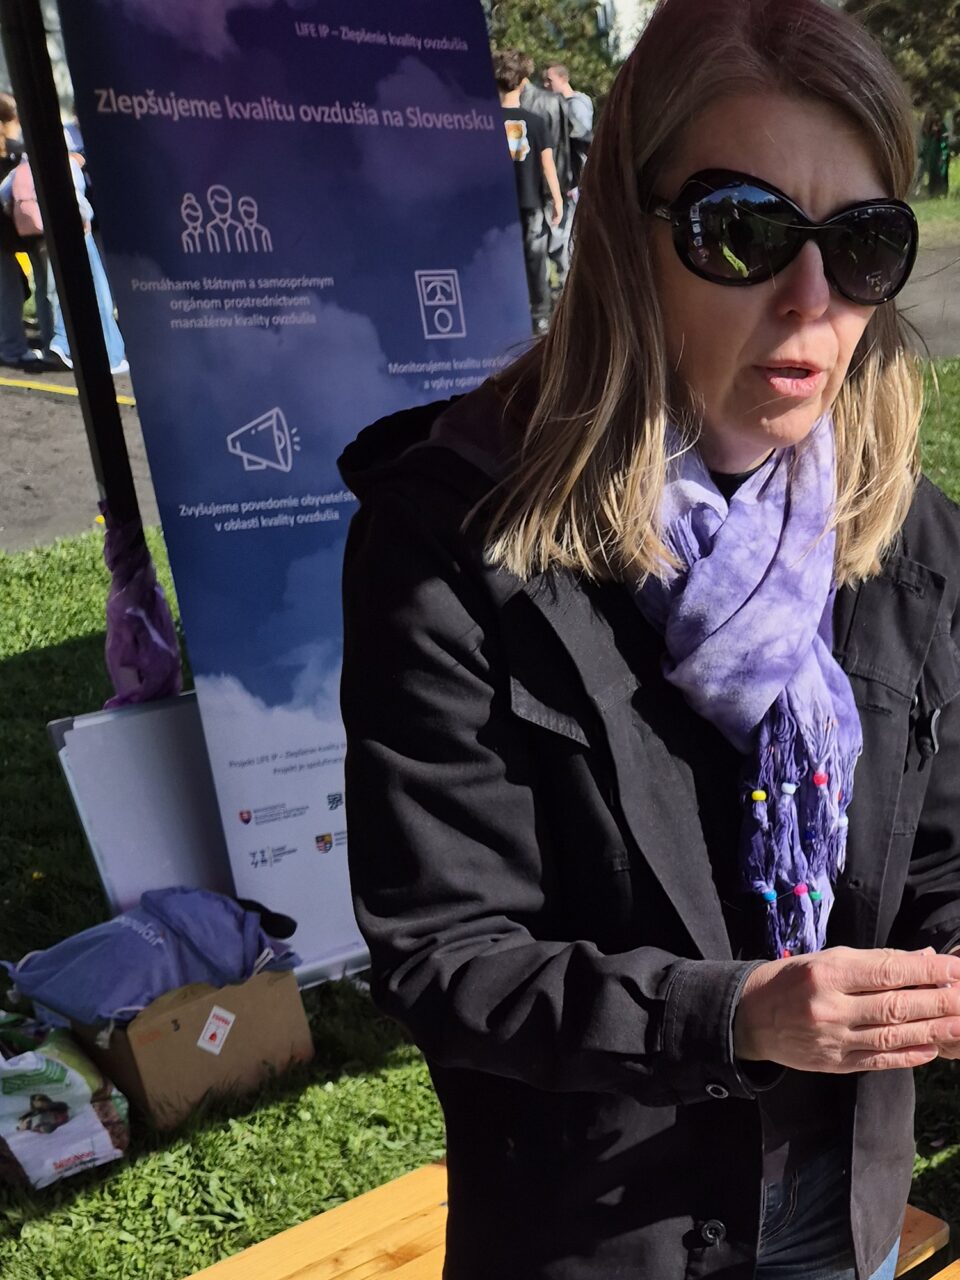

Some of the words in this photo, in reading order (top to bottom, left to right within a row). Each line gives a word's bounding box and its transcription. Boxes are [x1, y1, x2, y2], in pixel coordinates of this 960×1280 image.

[94, 88, 223, 121] Zlepšujeme
[224, 95, 296, 121] kvalitu
[299, 101, 379, 126] ovzdušia
[382, 109, 404, 127] na
[406, 106, 495, 131] Slovensku
[249, 280, 256, 289] a
